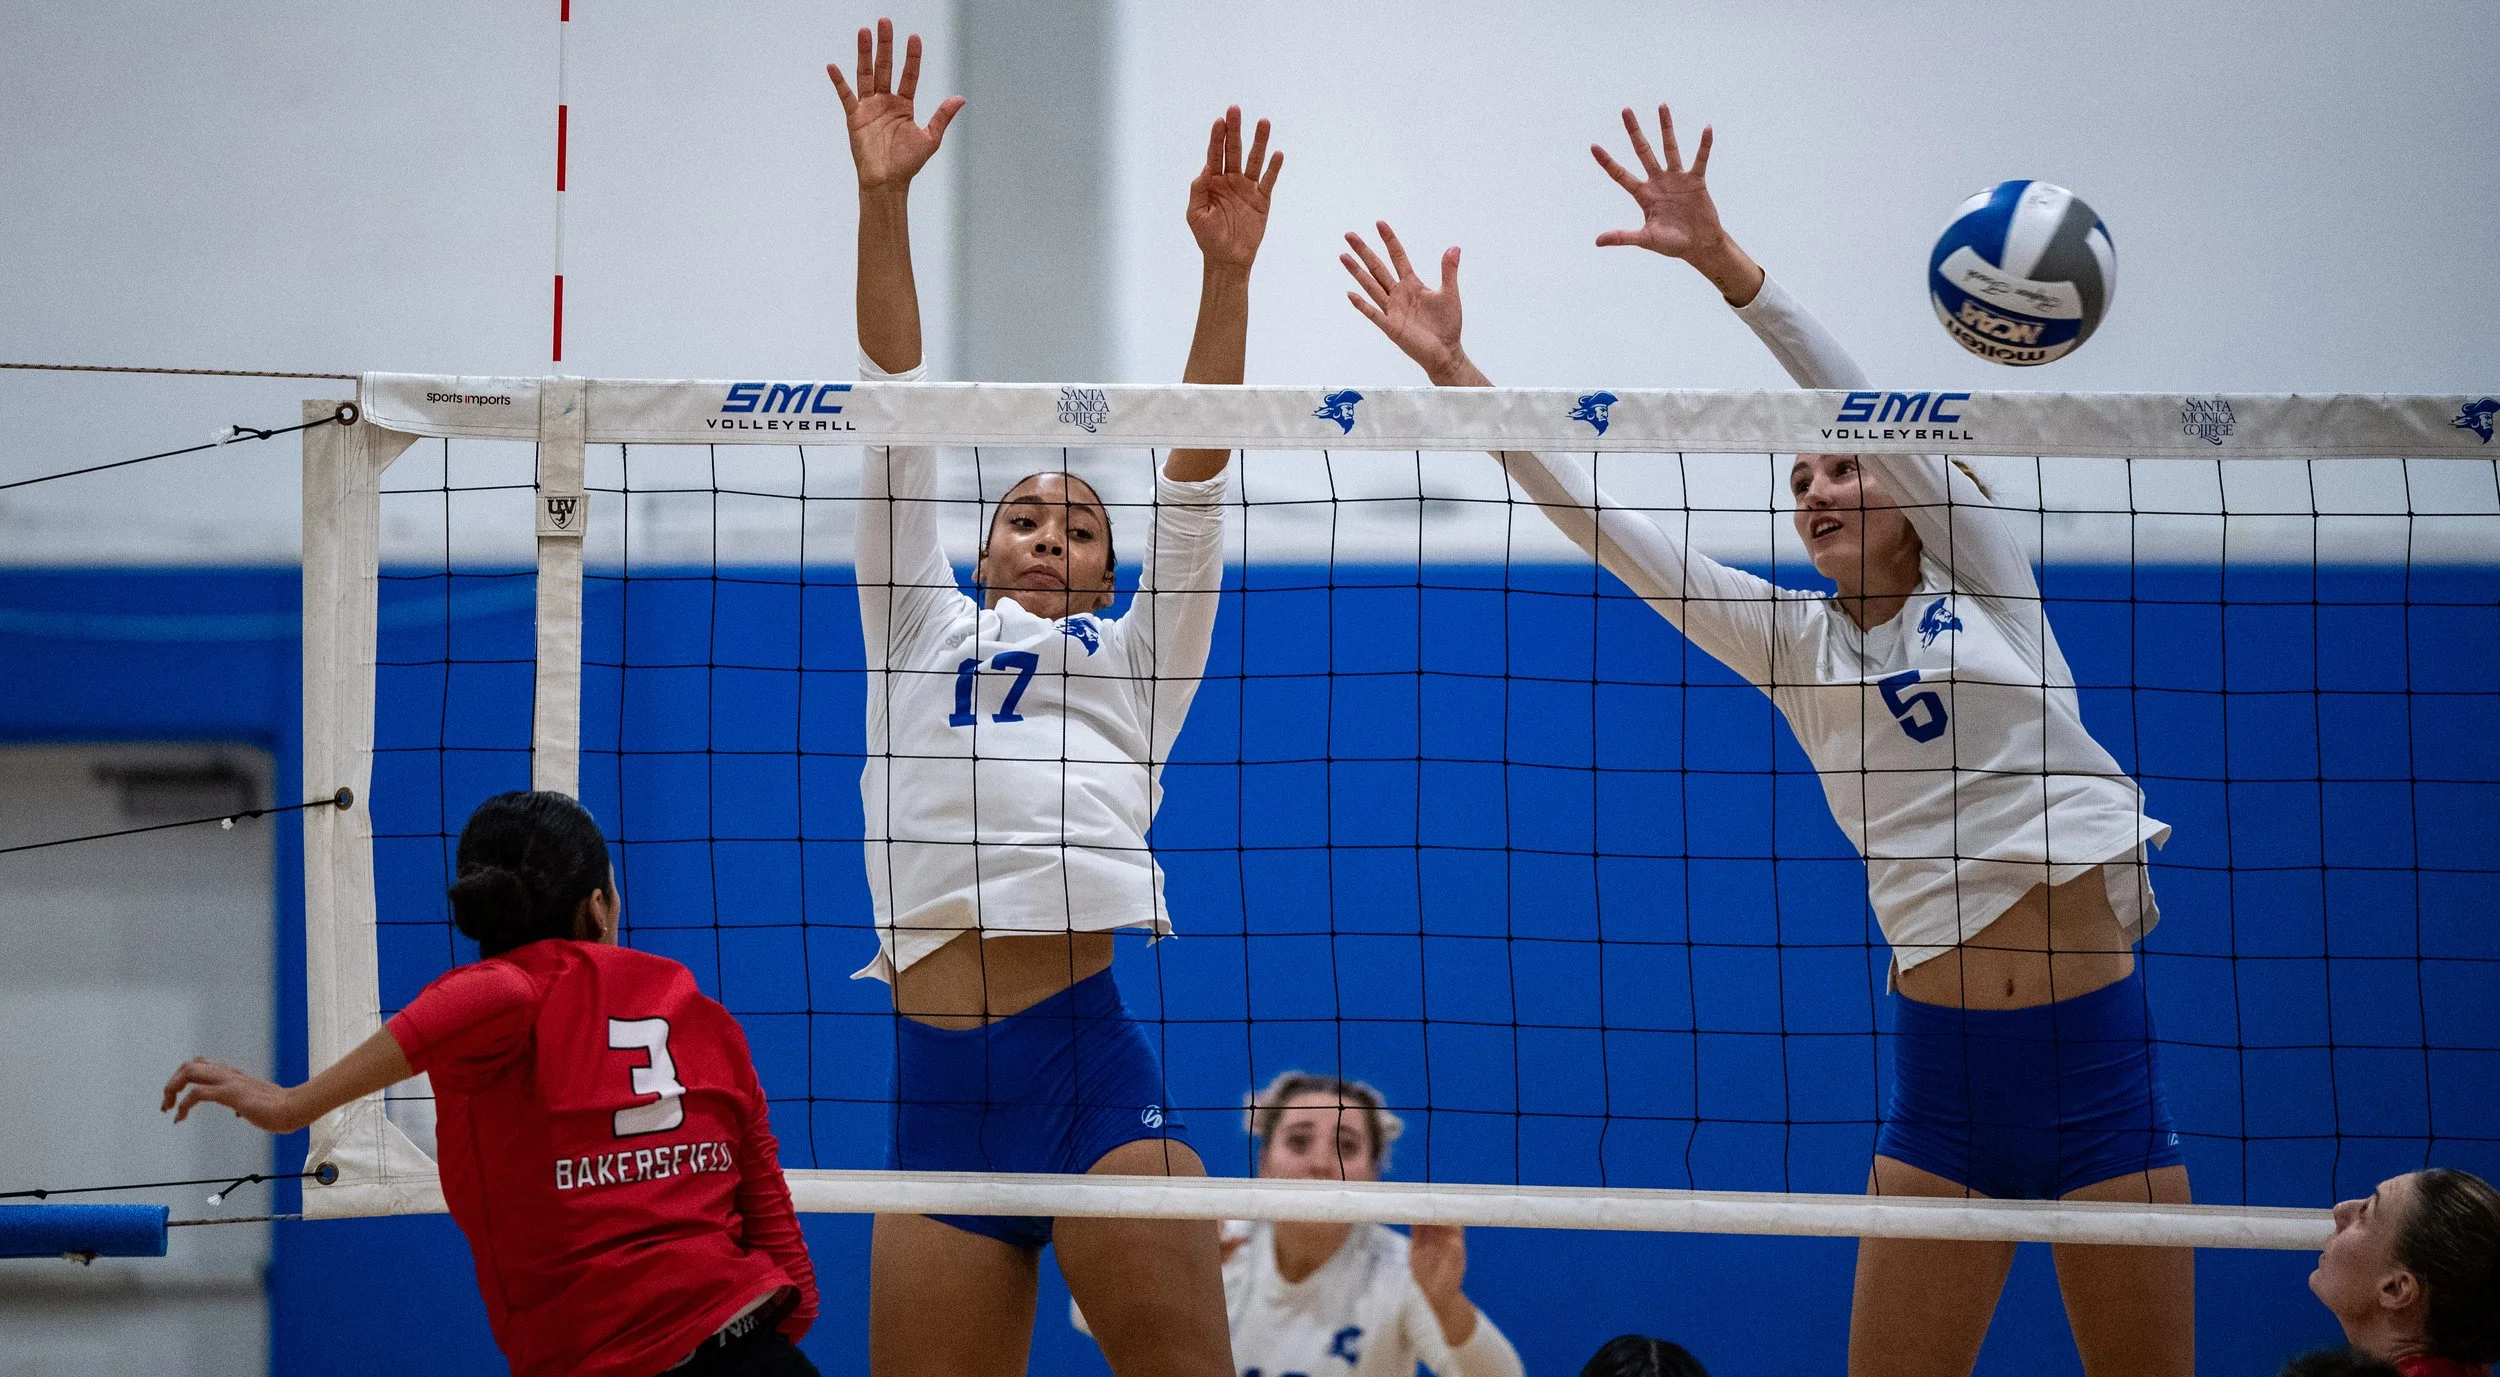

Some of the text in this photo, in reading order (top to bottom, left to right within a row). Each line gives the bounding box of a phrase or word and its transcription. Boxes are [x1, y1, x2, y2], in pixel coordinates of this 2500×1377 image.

[1956, 299, 2046, 345] NCAA
[1946, 319, 2046, 360] molten
[426, 392, 511, 407] sports imports
[721, 383, 853, 414] SMC
[1061, 386, 1106, 400] SANTA
[1057, 401, 1110, 412] MONICA
[1836, 391, 1971, 423] SMC
[2186, 397, 2232, 412] SANTA
[706, 419, 856, 431] VOLLEYBALL
[1059, 412, 1107, 433] COLLEGE
[2181, 412, 2237, 424] MONICA
[1821, 429, 1974, 440] VOLLEYBALL
[2183, 424, 2234, 445] COLLEGE
[949, 651, 1039, 727] 17
[1878, 669, 1948, 743] 5
[607, 1016, 687, 1138] 3
[555, 1142, 733, 1190] BAKERSFIELD
